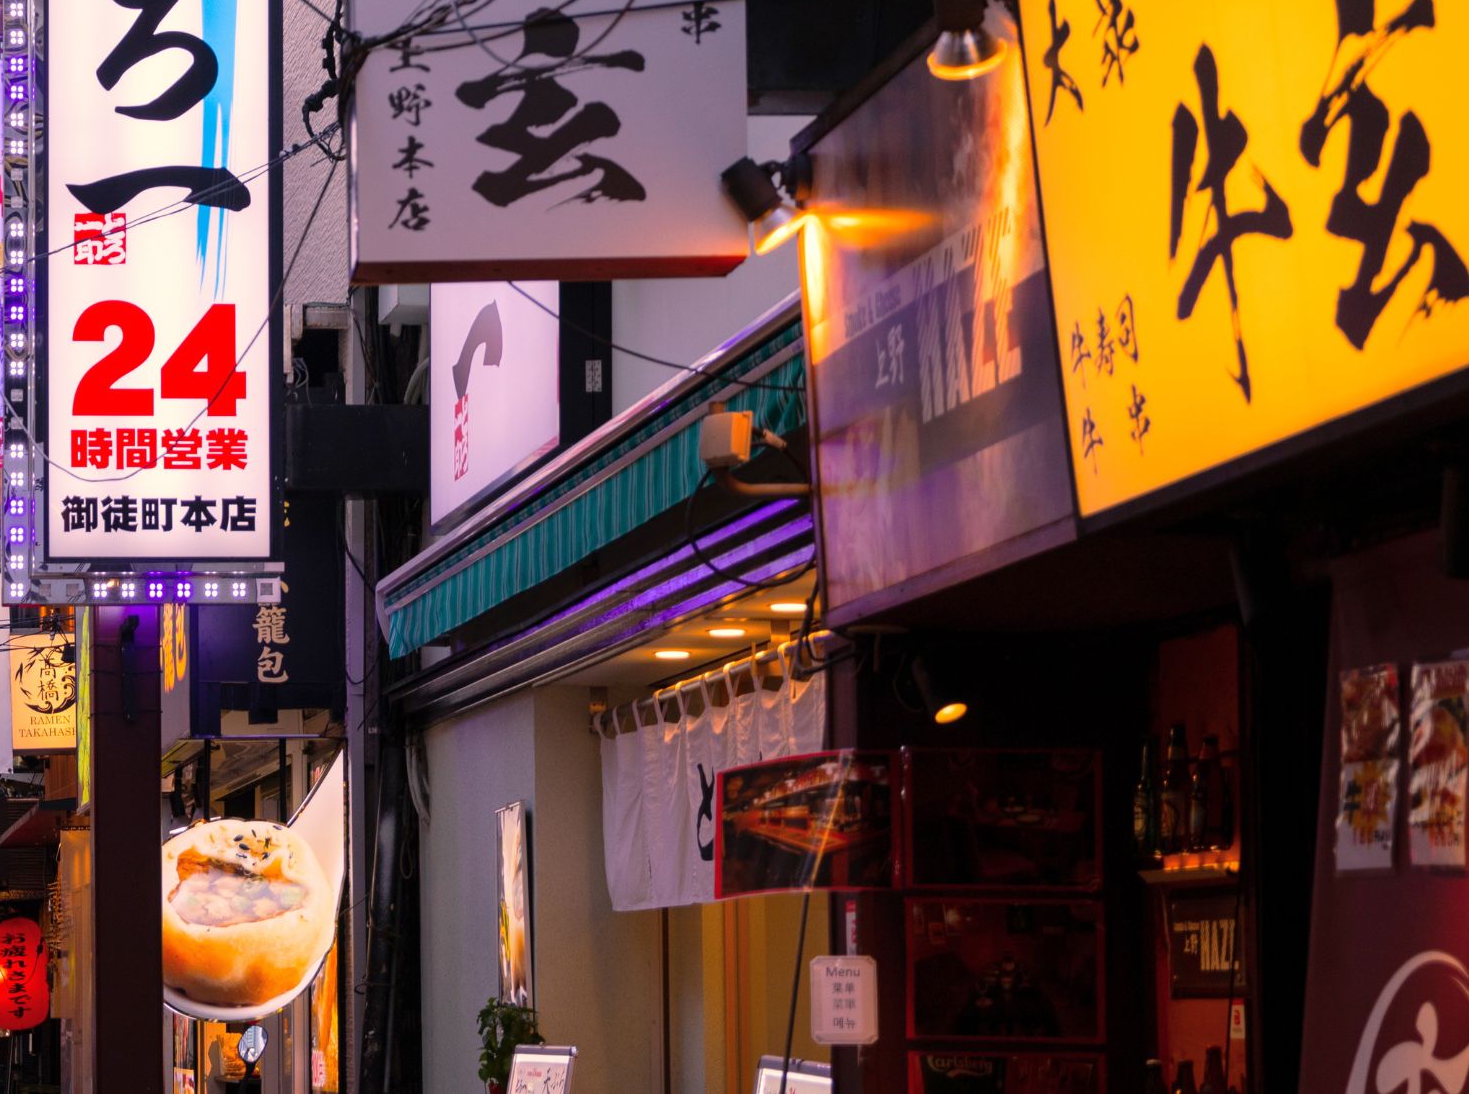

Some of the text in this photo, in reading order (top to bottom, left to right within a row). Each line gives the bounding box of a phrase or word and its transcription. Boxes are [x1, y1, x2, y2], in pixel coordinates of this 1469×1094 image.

[388, 34, 435, 232] 上野本店
[72, 300, 247, 417] 24
[70, 427, 248, 471] 時間営業
[61, 495, 257, 534] 御徒町本店
[30, 714, 71, 727] RAMEN
[825, 966, 861, 978] Menu
[832, 1016, 856, 1030] 메뉴
